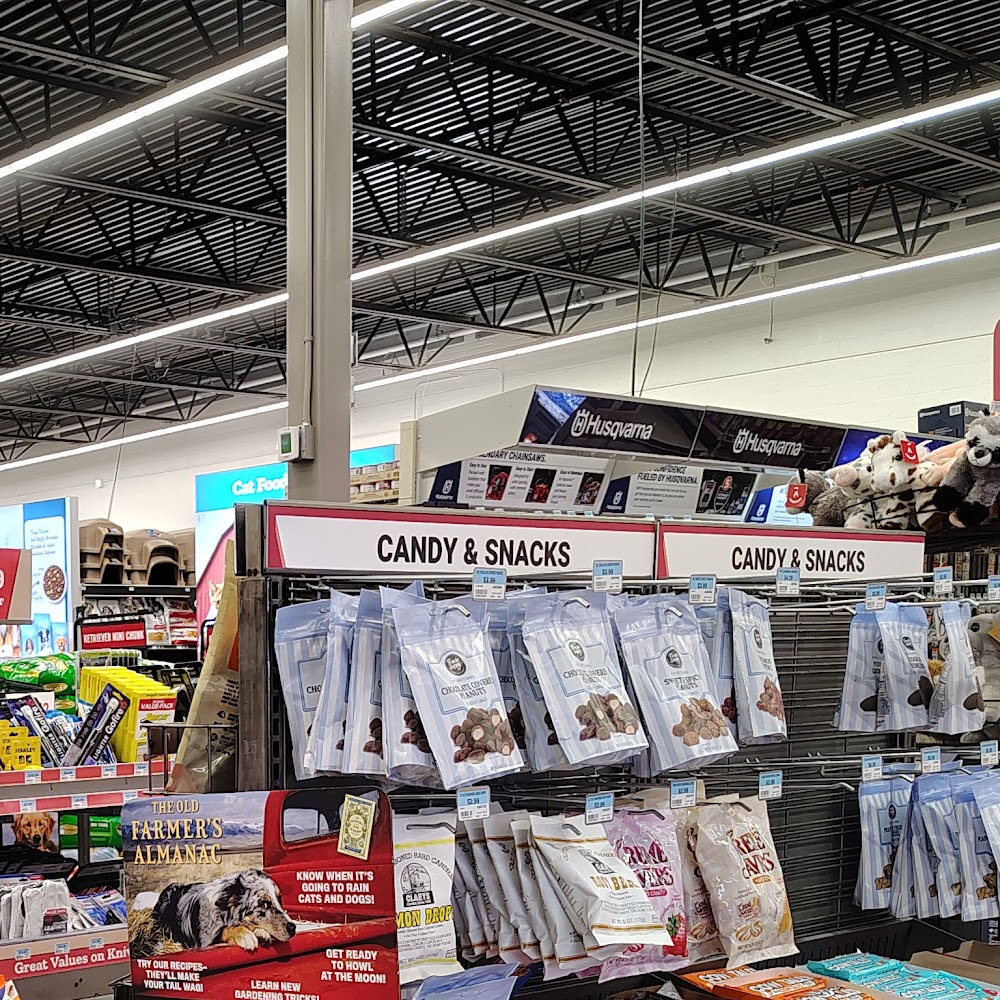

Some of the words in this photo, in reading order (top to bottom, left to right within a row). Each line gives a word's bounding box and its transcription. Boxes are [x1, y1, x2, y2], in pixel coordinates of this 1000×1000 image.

[588, 413, 652, 440] Husqvarna
[747, 433, 802, 456] Husqvarna
[637, 472, 656, 482] FUELED
[657, 474, 664, 483] BY
[665, 474, 698, 484] HUSQVARNA.
[232, 480, 254, 496] Cat
[257, 474, 288, 493] Food
[377, 534, 457, 567] CANDY
[461, 540, 479, 566] &
[484, 534, 570, 567] SNACKS
[732, 546, 787, 571] CANDY
[791, 552, 800, 568] &
[805, 549, 865, 572] SNACKS
[84, 632, 111, 644] RETRIEVER
[112, 631, 125, 642] MINI
[126, 628, 145, 641] CHUNK
[151, 801, 174, 814] THE
[176, 799, 199, 813] OLD
[131, 818, 224, 841] FARMER'S
[134, 843, 223, 866] ALMANAC
[296, 871, 324, 881] KNOW
[326, 871, 353, 881] WHEN
[355, 871, 374, 881] IT'S
[301, 883, 330, 892] GOING
[332, 883, 344, 892] TO
[346, 883, 369, 892] RAIN
[298, 894, 322, 904] CATS
[324, 894, 344, 904] AND
[345, 894, 375, 904] DOGS!
[326, 949, 343, 960] GET
[345, 950, 378, 960] READY
[14, 960, 49, 975] Great
[50, 953, 89, 968] Values
[90, 951, 105, 961] on
[137, 959, 153, 969] TRY
[155, 960, 169, 970] OUR
[331, 960, 344, 970] TO
[345, 961, 374, 972] HOWL
[145, 969, 175, 980] THEY'LL
[176, 971, 200, 982] MAKE
[320, 971, 333, 981] AT
[334, 972, 352, 982] THE
[354, 973, 386, 984] MOON!
[143, 980, 164, 990] YOUR
[165, 981, 181, 991] TAIL
[183, 982, 204, 993] WAG!
[250, 980, 279, 991] LEARN
[281, 982, 301, 993] NEW
